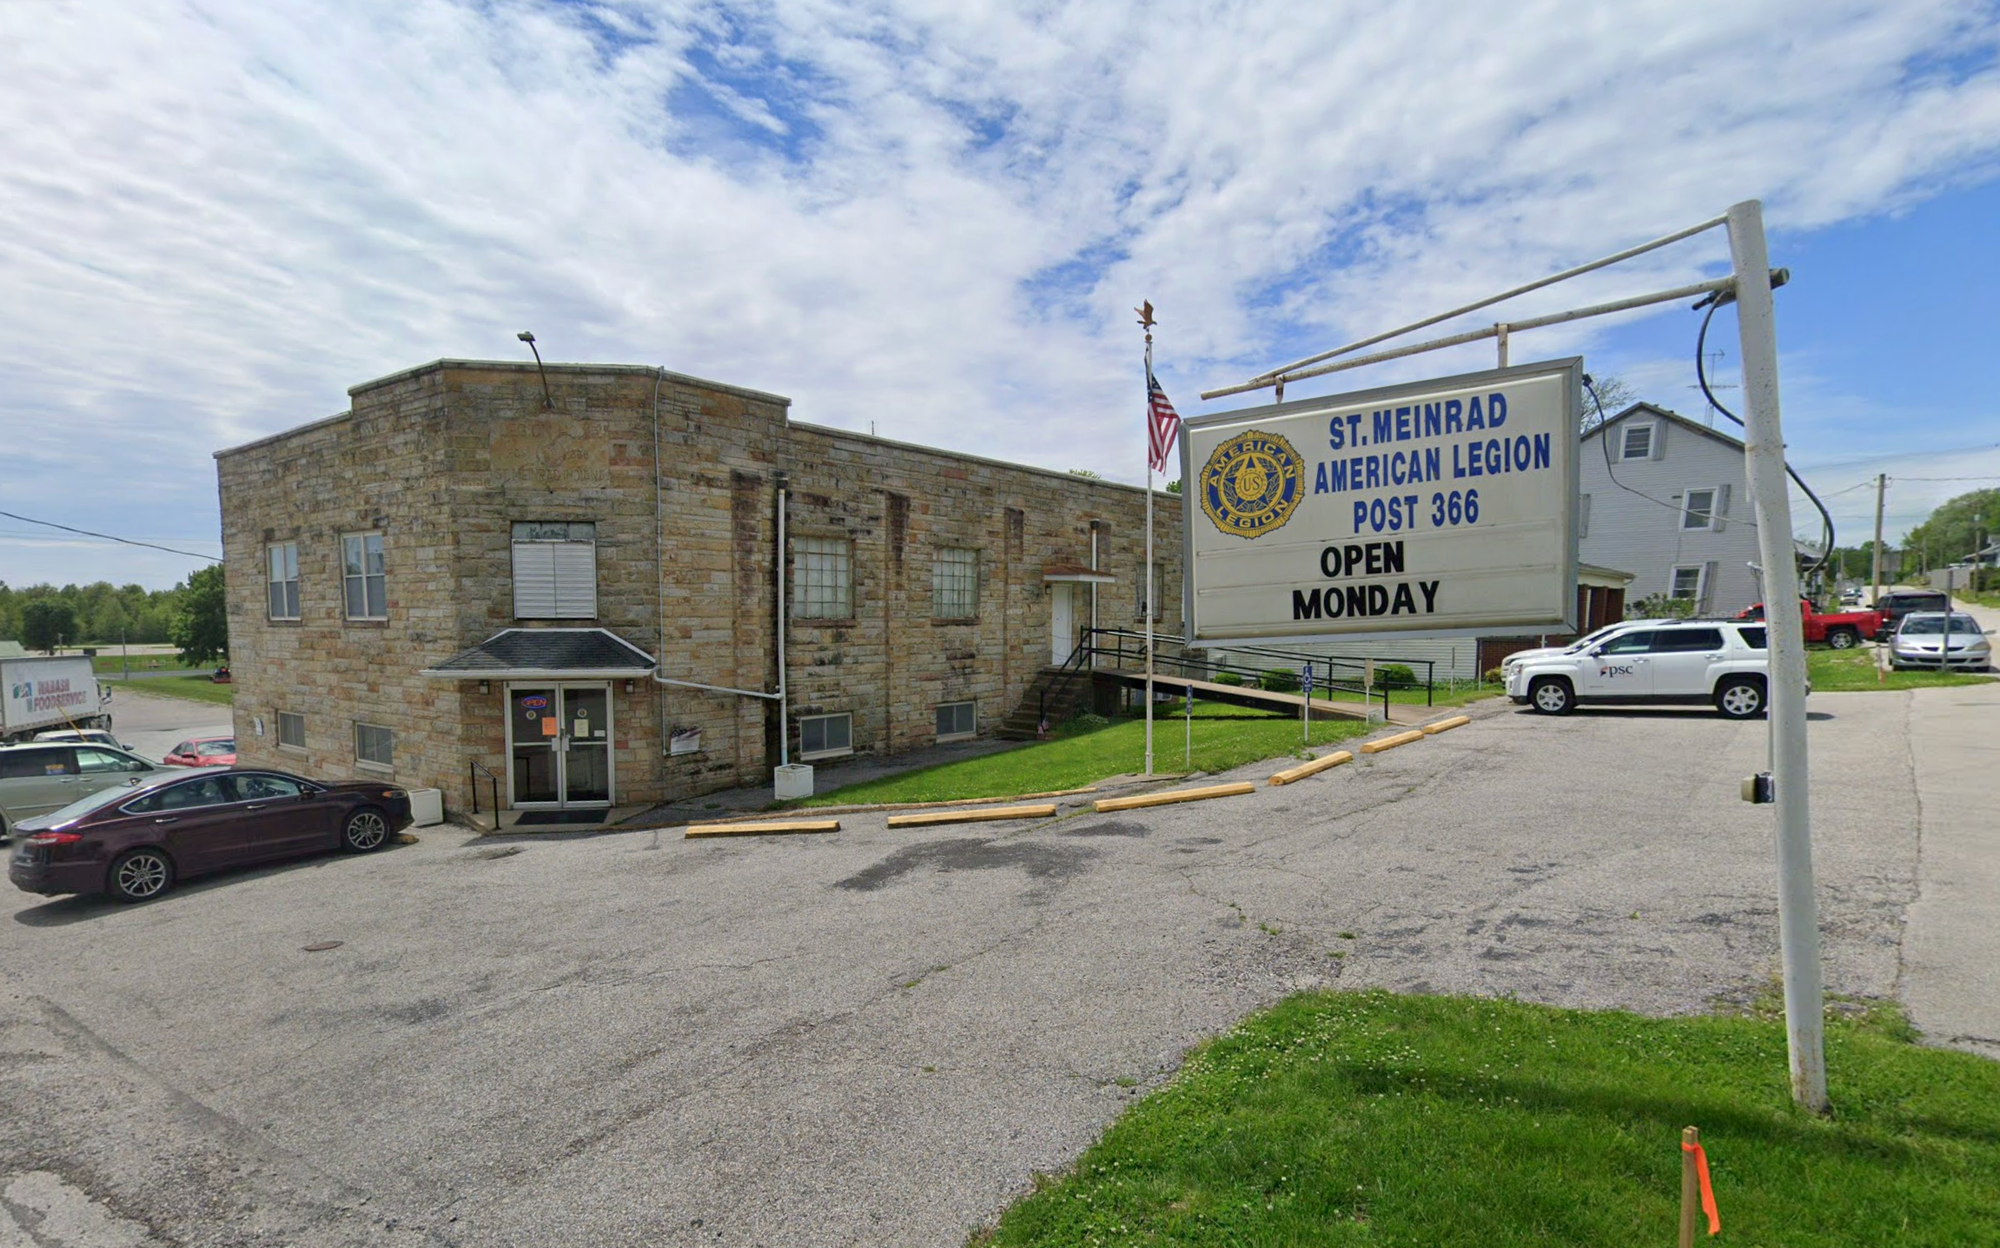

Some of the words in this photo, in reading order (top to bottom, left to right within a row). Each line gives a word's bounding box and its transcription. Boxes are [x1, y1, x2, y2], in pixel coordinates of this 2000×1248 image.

[1329, 413, 1367, 450] ST.
[1373, 392, 1507, 444] MEINRAD
[1209, 441, 1295, 488] AMERICAN
[1314, 446, 1441, 494] AMERICAN
[1453, 433, 1550, 479] LEGION
[1243, 476, 1260, 492] US
[1216, 499, 1289, 528] LEGION
[1354, 495, 1419, 534] POST
[1431, 488, 1479, 527] 366
[1320, 541, 1405, 578] OPEN
[1292, 580, 1440, 620] MONDAY
[38, 679, 70, 695] WABASH
[1609, 665, 1633, 678] psc
[34, 691, 87, 711] FOODSERVICE
[522, 698, 547, 707] OPEN
